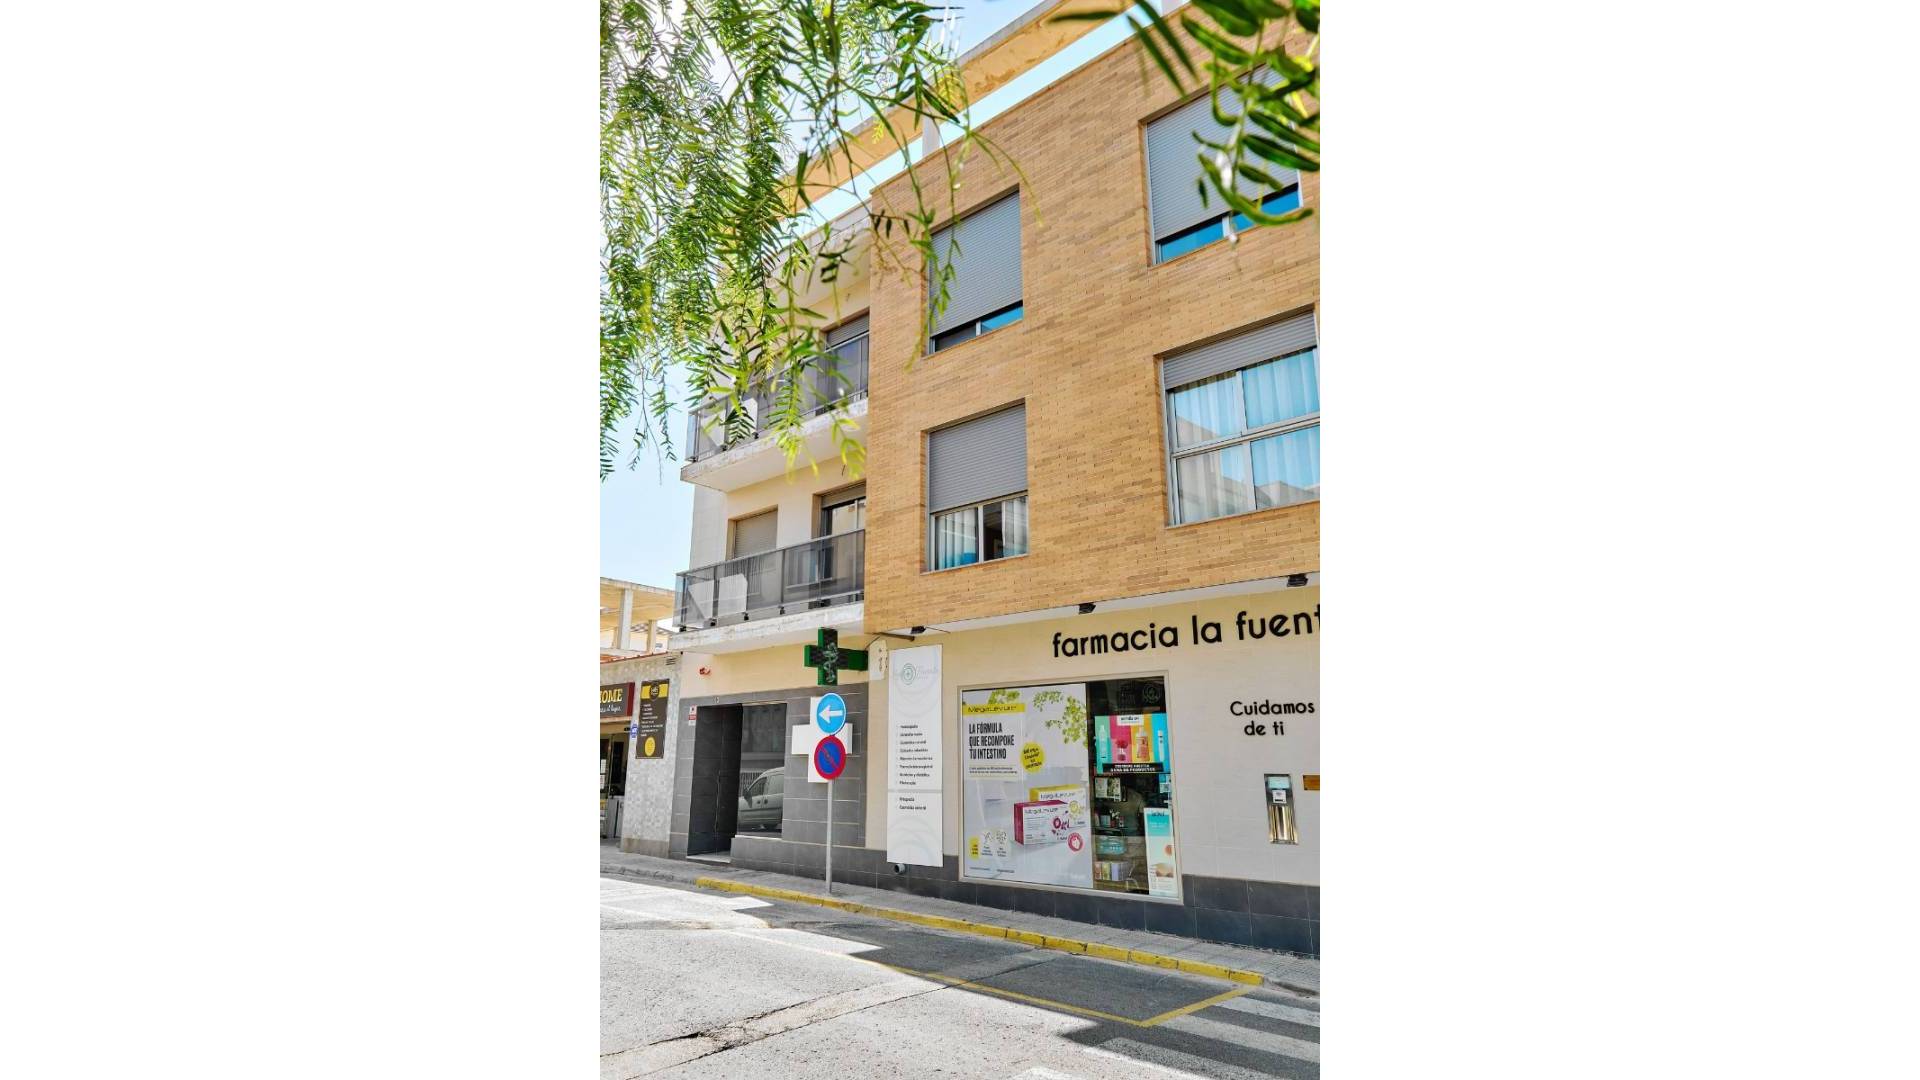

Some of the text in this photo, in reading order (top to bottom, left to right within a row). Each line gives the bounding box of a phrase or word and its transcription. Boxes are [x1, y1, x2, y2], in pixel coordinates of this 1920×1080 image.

[1052, 622, 1179, 658] farmacia
[1191, 614, 1222, 645] la
[600, 688, 624, 704] OME
[1229, 700, 1315, 717] Cuidamos
[968, 723, 976, 734] LA
[1243, 720, 1285, 737] de ti
[969, 736, 980, 748] QUE
[969, 748, 1007, 760] TU INTESTINO
